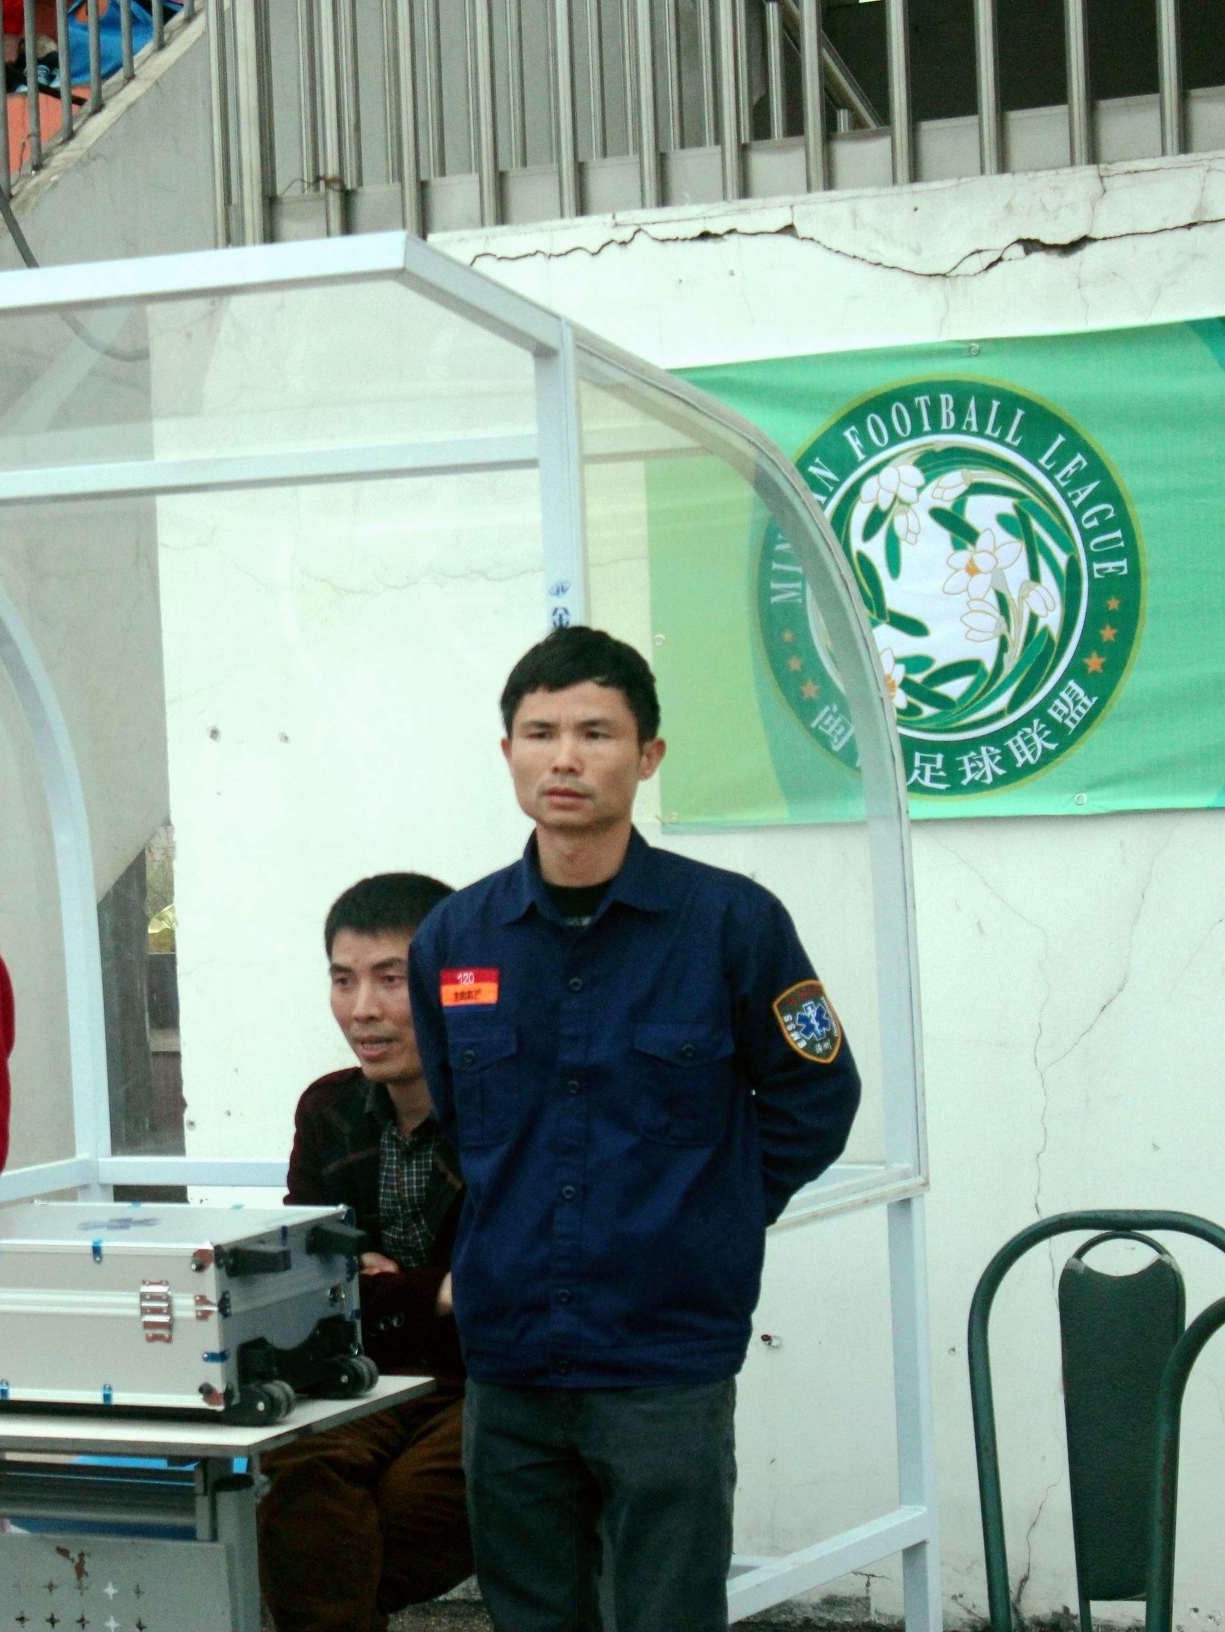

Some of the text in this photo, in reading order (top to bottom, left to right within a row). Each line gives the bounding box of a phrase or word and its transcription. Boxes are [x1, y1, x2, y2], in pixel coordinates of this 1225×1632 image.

[843, 394, 1025, 463] FOOTBALL
[1038, 433, 1128, 579] LEAGUE
[810, 679, 1099, 791] 闽足球联盟
